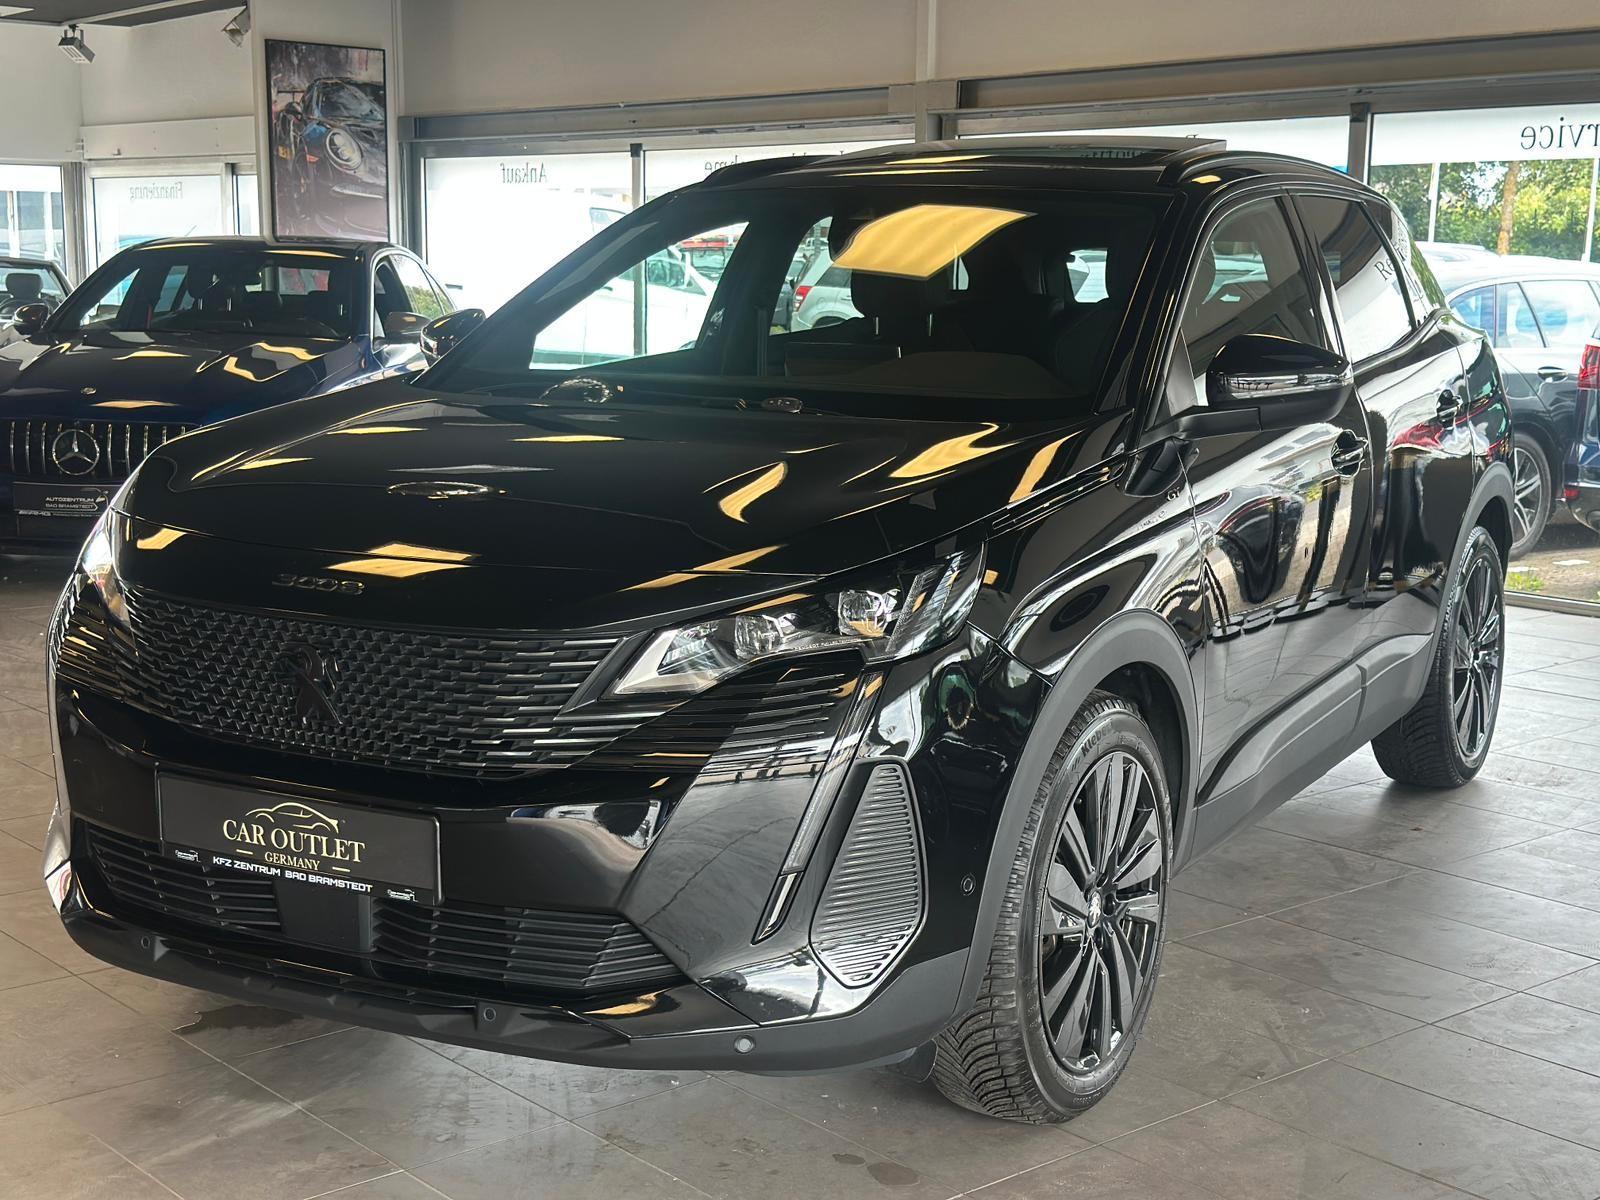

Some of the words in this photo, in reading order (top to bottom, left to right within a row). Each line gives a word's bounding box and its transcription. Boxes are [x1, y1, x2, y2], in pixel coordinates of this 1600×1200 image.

[223, 819, 266, 846] CAR
[270, 828, 366, 863] OUTLET
[213, 856, 232, 867] KFZ
[233, 860, 281, 876] ZENTRUM
[285, 870, 307, 881] BAD
[308, 874, 373, 893] BRAMSTEDT
[264, 851, 320, 871] GERMANY
